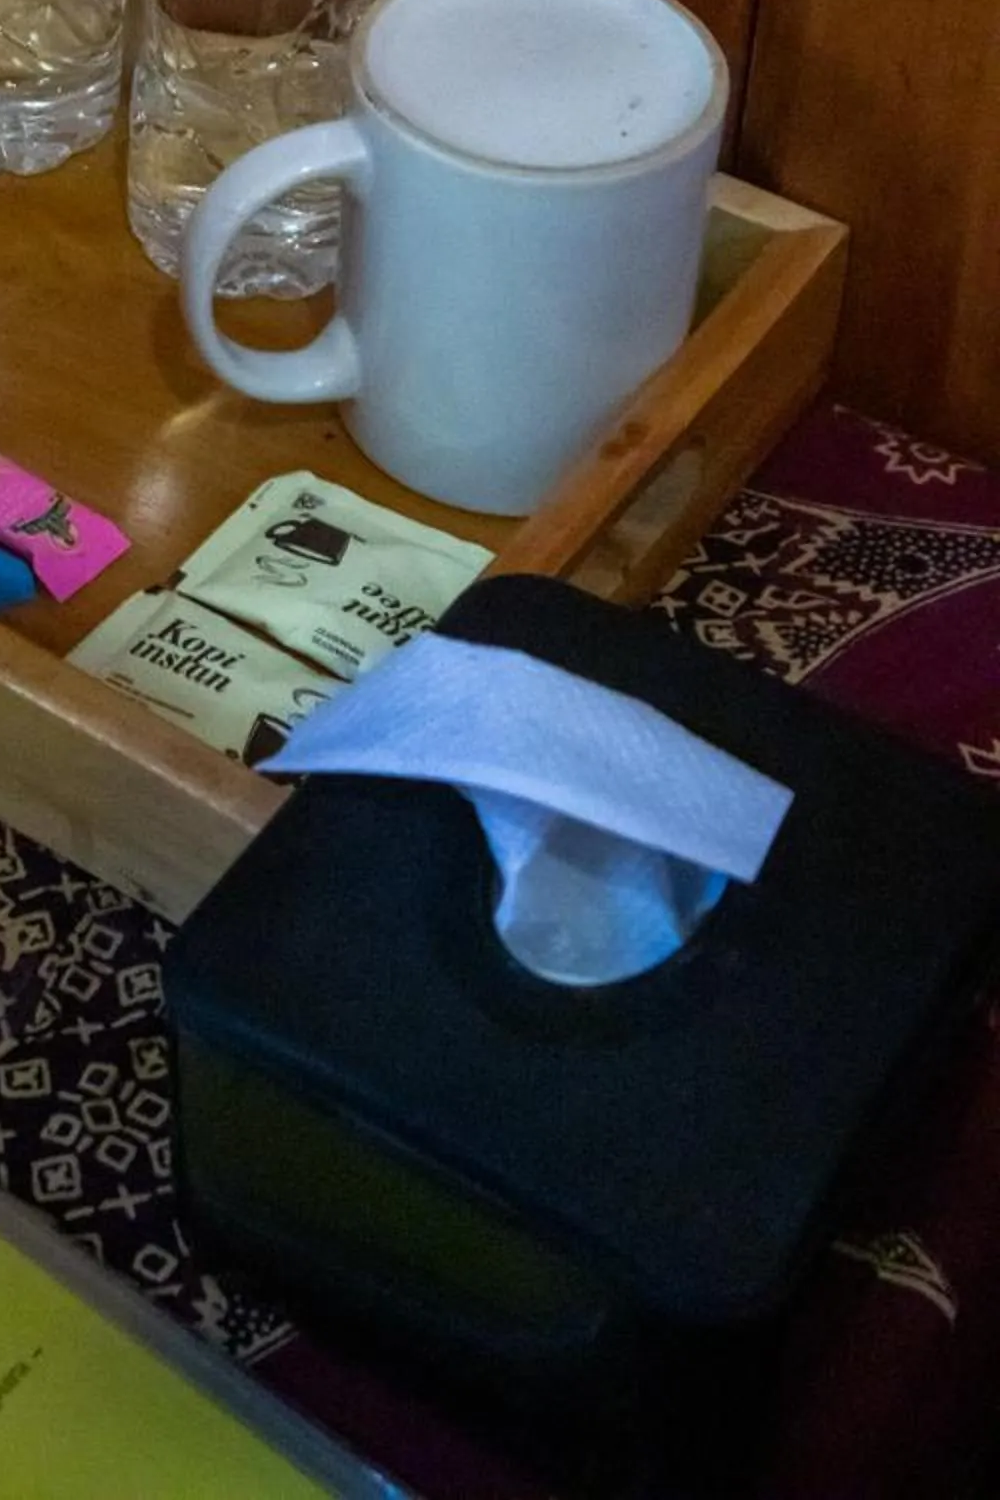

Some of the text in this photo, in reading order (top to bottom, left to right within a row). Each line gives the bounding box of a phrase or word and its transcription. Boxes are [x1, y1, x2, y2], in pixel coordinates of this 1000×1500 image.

[360, 582, 436, 633] ffee
[129, 640, 232, 693] instan
[147, 618, 246, 669] Kopi
